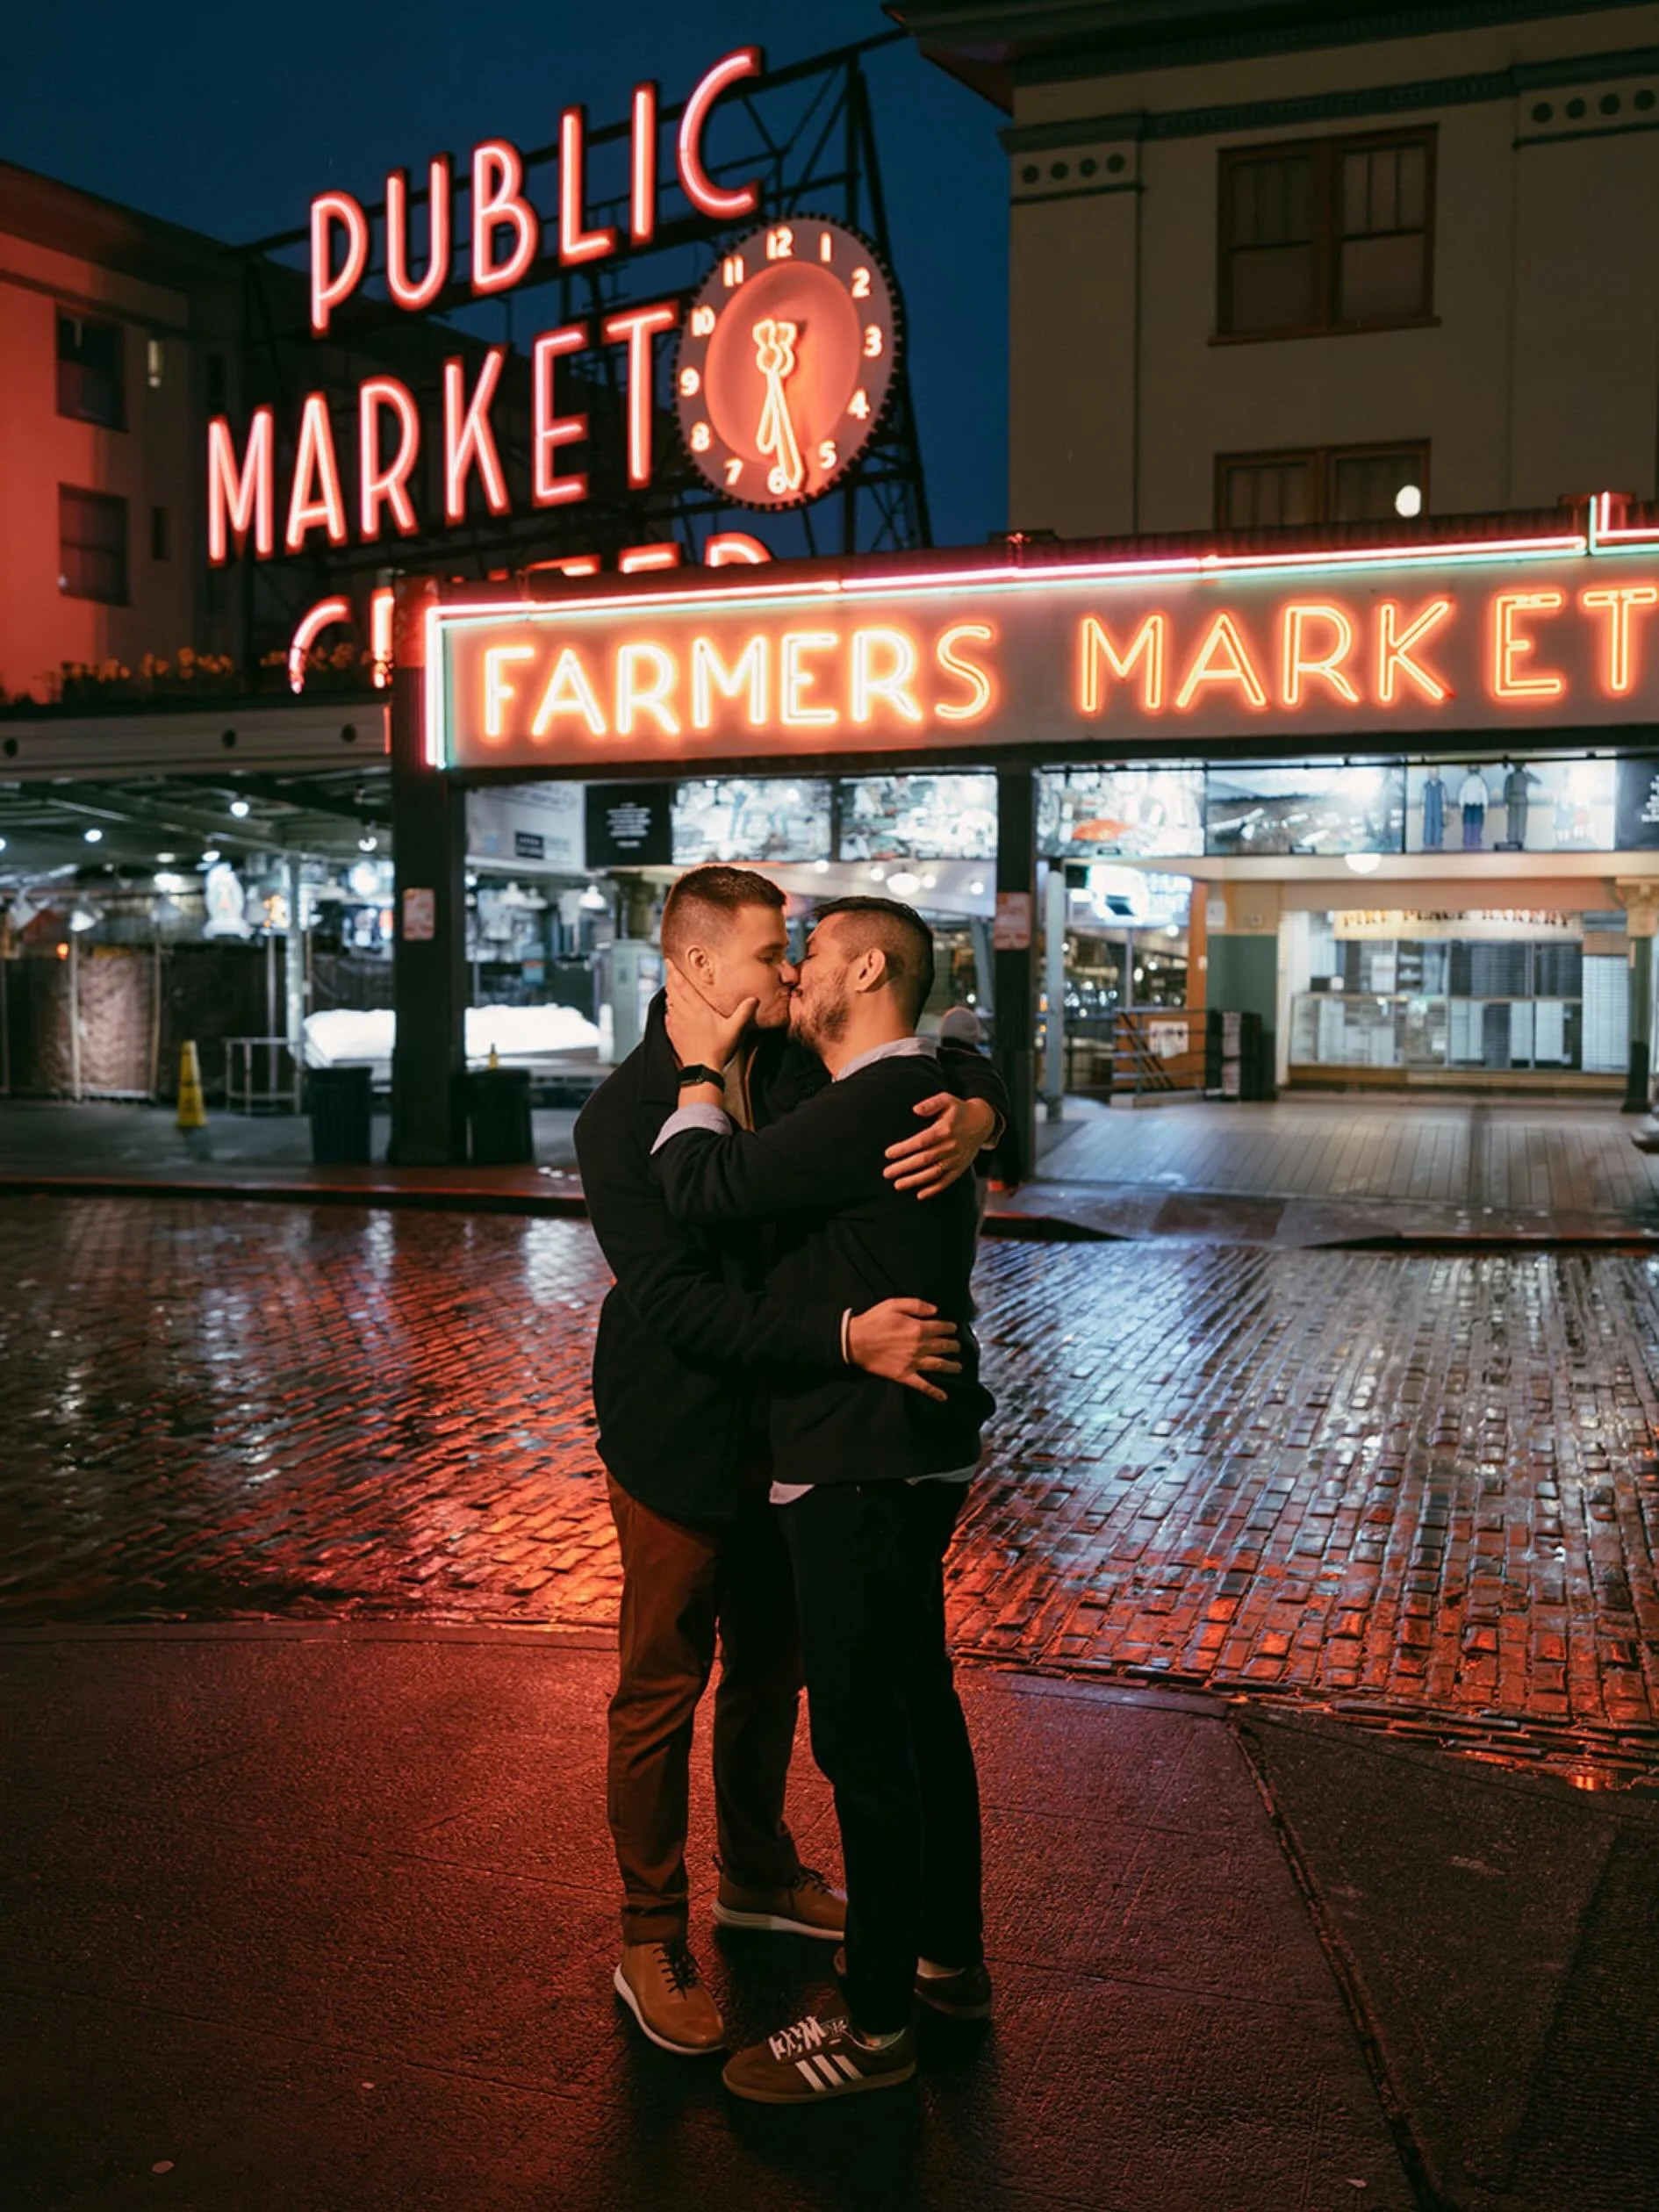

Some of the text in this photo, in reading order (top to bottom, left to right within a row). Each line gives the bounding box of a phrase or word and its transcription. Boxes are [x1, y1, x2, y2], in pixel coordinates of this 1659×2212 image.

[310, 45, 764, 338] PUBLIC
[766, 226, 794, 260] 12
[821, 232, 832, 262] 1
[723, 255, 744, 287] 11
[851, 267, 871, 298] 2
[691, 305, 715, 337] 10
[864, 324, 883, 357] 3
[679, 367, 700, 397] 9
[847, 389, 871, 420] 4
[207, 300, 680, 568] MARKET
[691, 421, 710, 452] 8
[818, 440, 837, 470] 5
[724, 458, 743, 485] 7
[768, 466, 787, 494] 6
[482, 587, 1659, 738] FARMERS MARKET
